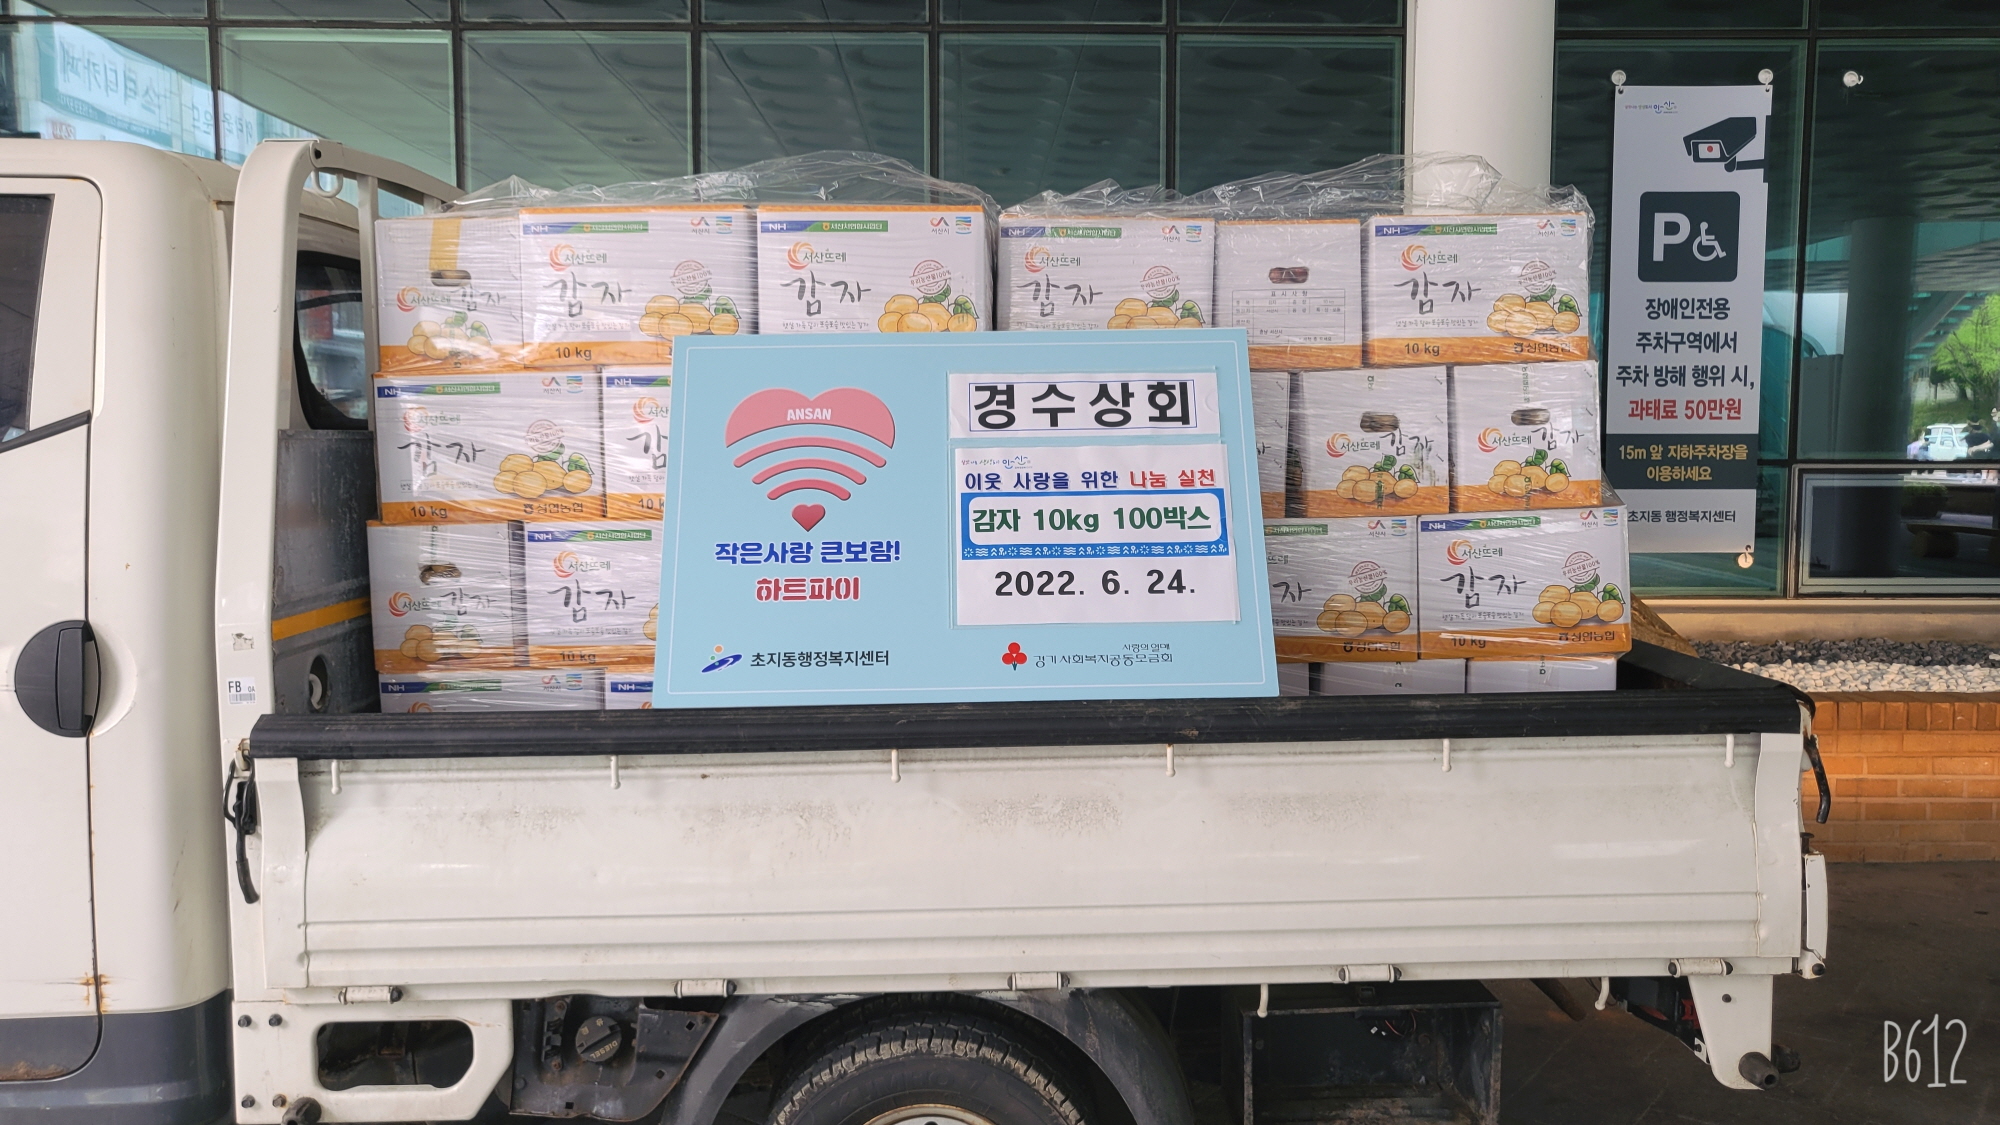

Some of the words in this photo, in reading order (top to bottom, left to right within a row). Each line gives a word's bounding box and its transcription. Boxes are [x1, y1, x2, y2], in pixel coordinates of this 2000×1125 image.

[531, 225, 548, 233] NH
[1653, 213, 1691, 261] P
[564, 250, 607, 265] 서산뜨레
[803, 249, 847, 264] 서산뜨레
[1039, 253, 1081, 267] 서산뜨레
[1416, 250, 1458, 265] 서산뜨레
[543, 271, 632, 318] 감자
[780, 270, 872, 317] 감자
[1016, 273, 1103, 318] 감자
[1393, 271, 1482, 315] 감자
[1645, 297, 1731, 320] 장애인전용
[1404, 343, 1420, 355] 10
[1424, 342, 1440, 356] kg
[1635, 331, 1738, 354] 주차구역에서
[555, 347, 571, 359] 10
[575, 346, 592, 360] kg
[614, 378, 632, 386] NH
[1616, 365, 1649, 387] 주차
[1654, 365, 1686, 387] 방해
[1692, 365, 1725, 387] 행위
[1730, 365, 1755, 390] 시,
[973, 380, 1191, 430] 경수상회
[1628, 398, 1678, 421] 과태료
[1684, 398, 1742, 421] 50만원
[787, 407, 832, 421] ANSAN
[1380, 428, 1434, 456] 감자
[1492, 432, 1532, 447] 서산뜨레
[1531, 421, 1585, 451] 감자
[1340, 437, 1381, 452] 서산뜨레
[1619, 445, 1647, 459] 15m
[1650, 444, 1663, 460] 앞
[1668, 444, 1749, 460] 지하주차장을
[397, 432, 486, 477] 감자
[965, 472, 1002, 491] 이웃
[1013, 472, 1070, 490] 사랑을
[1081, 470, 1119, 489] 위한
[1129, 470, 1167, 489] 나눔
[1177, 468, 1216, 488] 실천
[1646, 466, 1713, 482] 이용하세요
[411, 505, 427, 518] 10
[430, 505, 448, 519] kg
[638, 498, 654, 510] 10
[972, 508, 1021, 533] 감자
[1033, 508, 1100, 533] 10kg
[1113, 505, 1212, 530] 100박스
[1581, 520, 1599, 528] 서산시
[1627, 510, 1662, 523] 초지동
[1665, 510, 1736, 523] 행정복지센터
[1368, 529, 1387, 537] 서산시
[1429, 522, 1446, 530] NH
[535, 532, 552, 540] NH
[715, 541, 814, 565] 작은사랑
[820, 540, 901, 564] 큰보람!
[1461, 543, 1504, 559] 서산뜨레
[568, 558, 611, 572] 서산뜨레
[756, 576, 860, 602] 하트파이
[995, 570, 1085, 597] 2022.
[1101, 569, 1130, 595] 6.
[1146, 569, 1196, 595] 24.
[1439, 566, 1527, 609] 감자
[440, 587, 497, 616] 감자
[547, 578, 636, 623] 감자
[1451, 636, 1466, 647] 10
[1470, 636, 1487, 649] kg
[560, 651, 574, 662] 10
[579, 651, 597, 664] kg
[751, 651, 889, 668] 초지동행정복지센터
[228, 680, 242, 693] FB
[388, 684, 405, 692] NH
[618, 683, 635, 691] NH
[590, 1040, 618, 1059] DIESEL
